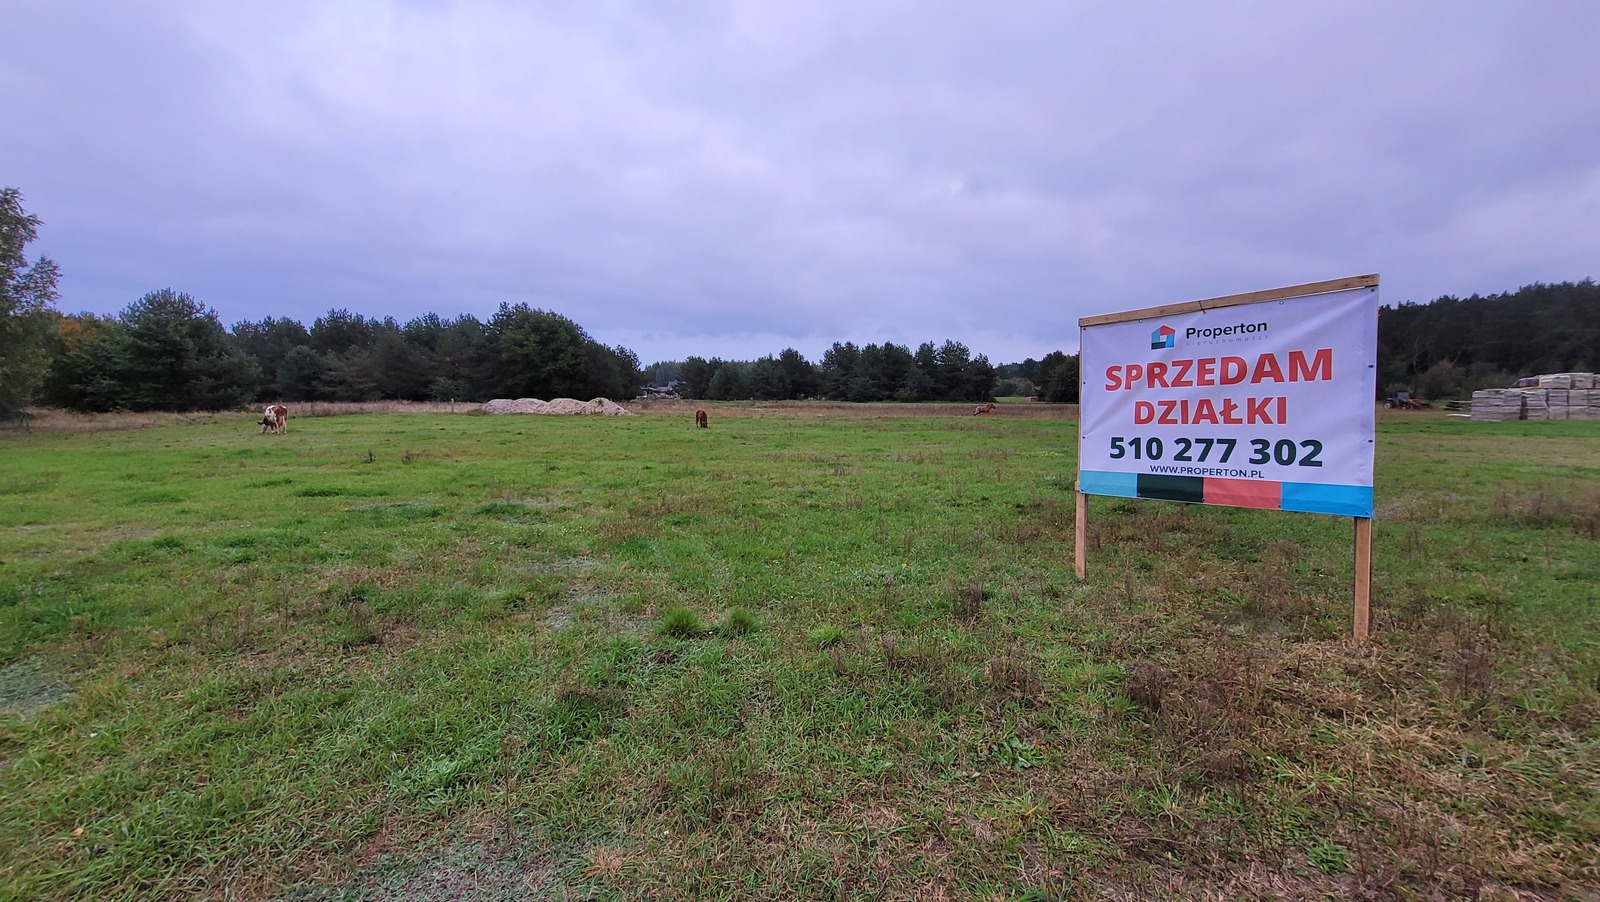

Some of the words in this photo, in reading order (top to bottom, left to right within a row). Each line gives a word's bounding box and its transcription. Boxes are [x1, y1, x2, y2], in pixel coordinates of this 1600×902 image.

[1186, 321, 1267, 339] Properton
[1104, 348, 1333, 391] SPRZEDAM
[1134, 396, 1287, 425] DZIAŁKI
[1109, 437, 1163, 460] 510
[1173, 438, 1237, 463] 277
[1248, 438, 1323, 467] 302
[1149, 465, 1265, 479] WWW.PROPERTON.PL
